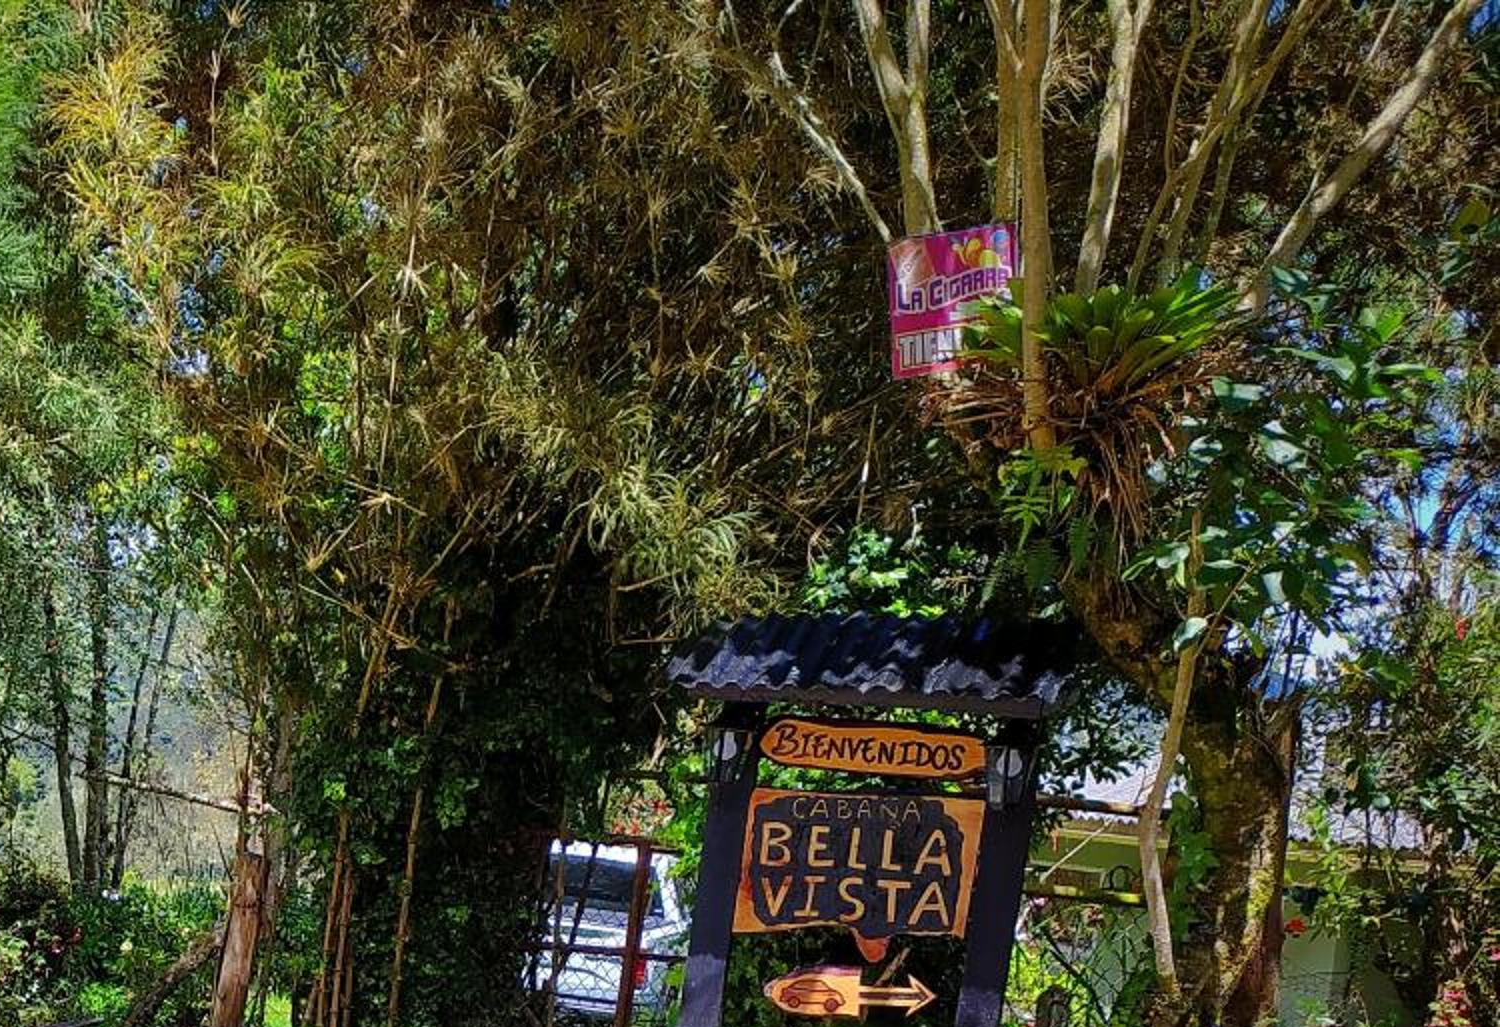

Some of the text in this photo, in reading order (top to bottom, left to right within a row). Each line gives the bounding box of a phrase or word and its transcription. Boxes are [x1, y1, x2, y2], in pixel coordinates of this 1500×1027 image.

[897, 282, 924, 312] LA
[772, 724, 967, 771] BIENVENIDOS
[759, 822, 952, 878] BELLA
[761, 875, 951, 927] VISTA
